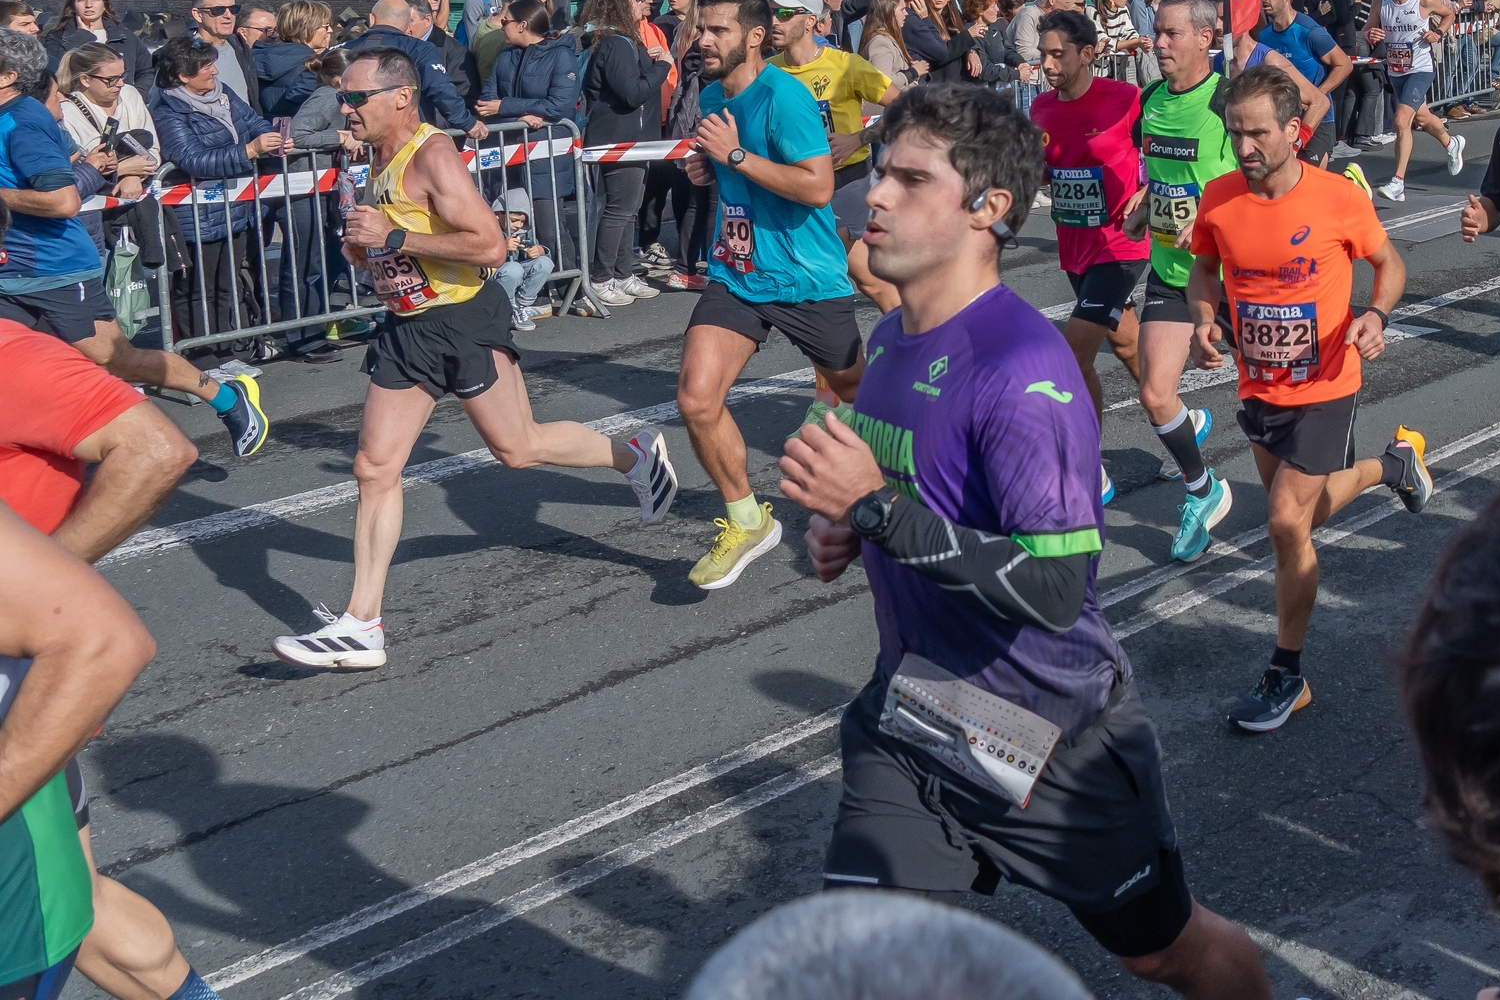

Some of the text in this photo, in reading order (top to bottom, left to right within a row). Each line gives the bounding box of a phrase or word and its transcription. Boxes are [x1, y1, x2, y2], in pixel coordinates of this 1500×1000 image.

[1388, 50, 1411, 59] 3654
[1150, 143, 1195, 157] forum sport
[1060, 169, 1092, 179] Joma
[1053, 181, 1100, 200] 2284
[1158, 184, 1188, 197] Joma
[1073, 201, 1100, 209] FREIRE
[1153, 198, 1190, 220] 245
[726, 221, 749, 242] 40
[1278, 266, 1301, 275] TRAIL
[396, 278, 414, 290] PAU
[1277, 273, 1307, 283] SERIES
[1257, 306, 1303, 319] Joma
[1243, 321, 1310, 347] 3822
[1260, 350, 1291, 359] ARITZ
[912, 380, 942, 397] FORTUNA
